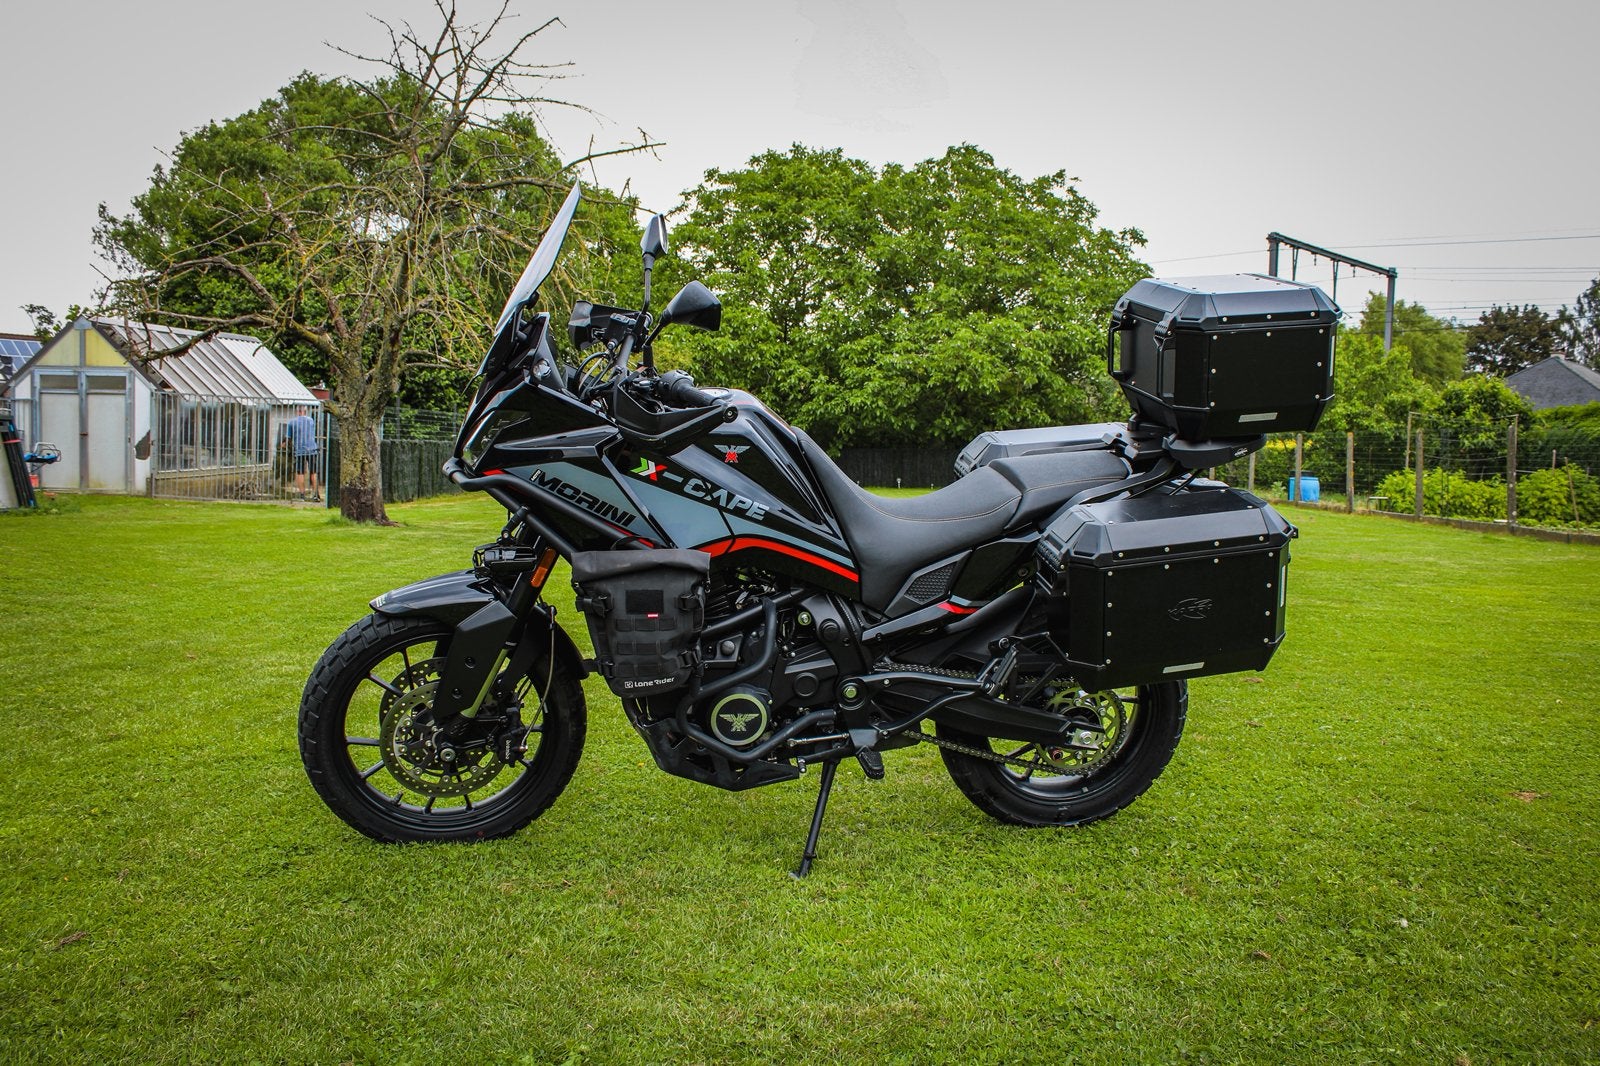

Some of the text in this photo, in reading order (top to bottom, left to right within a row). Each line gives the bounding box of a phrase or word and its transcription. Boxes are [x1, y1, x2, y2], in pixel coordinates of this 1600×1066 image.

[535, 471, 637, 527] MORINI
[629, 457, 770, 521] X-CAPE
[634, 677, 675, 688] Lone Rider
